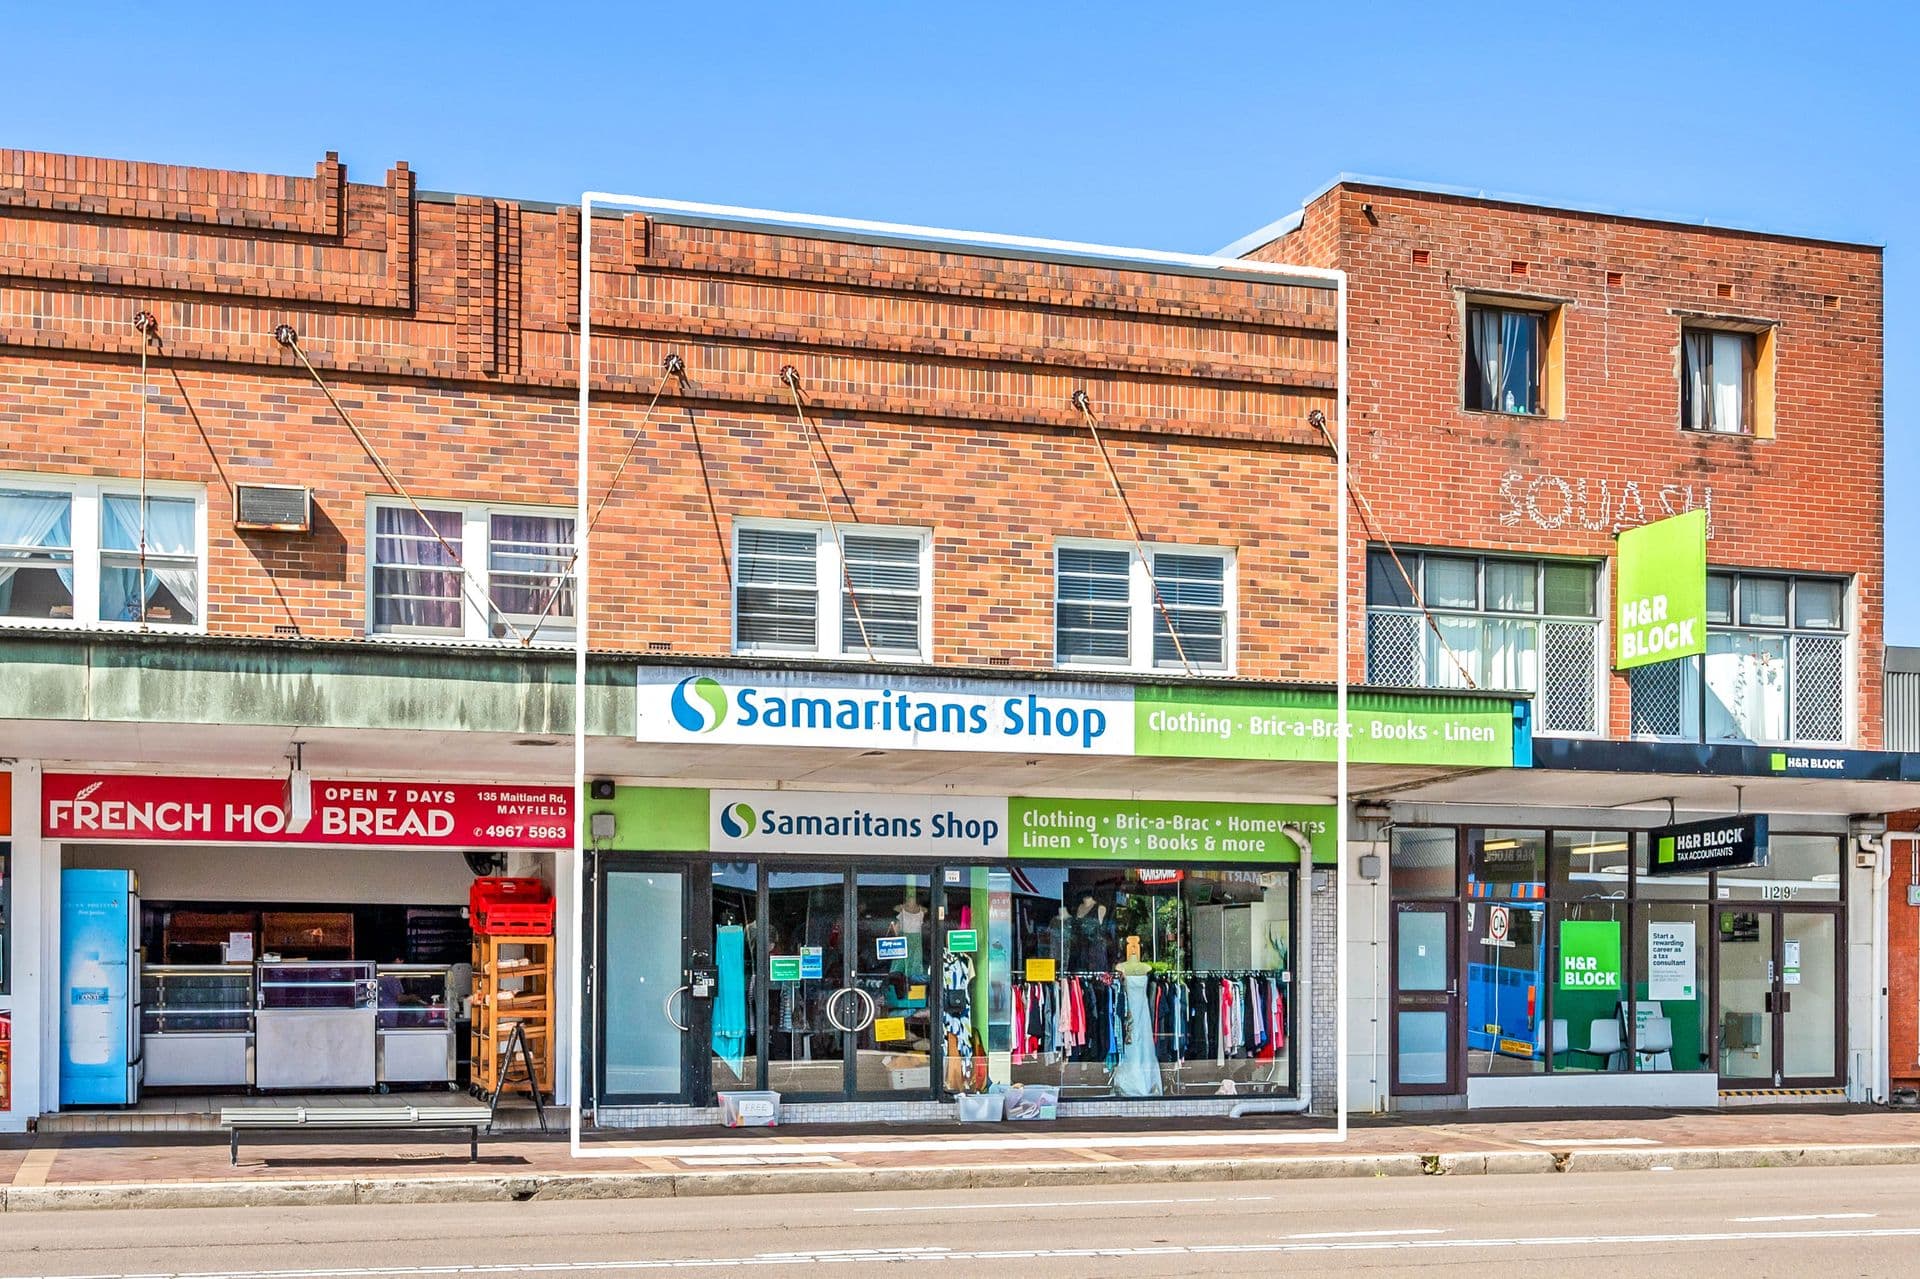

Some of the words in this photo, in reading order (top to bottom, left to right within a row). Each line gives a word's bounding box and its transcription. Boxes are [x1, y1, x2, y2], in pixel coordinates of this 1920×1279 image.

[1623, 595, 1667, 630] H&R
[1623, 619, 1694, 659] BLOCK
[737, 689, 988, 734] Samaritans
[1003, 694, 1106, 748] Shop
[1149, 710, 1231, 739] Clothing
[1371, 719, 1427, 740] Books
[1445, 721, 1495, 742] Linen
[1788, 757, 1809, 768] H&R
[1810, 758, 1845, 770] BLOCK
[325, 788, 378, 801] OPEN
[388, 790, 397, 802] 7
[406, 790, 456, 803] DAYS
[477, 792, 497, 801] 135
[500, 792, 546, 803] Maitland
[549, 793, 567, 804] Rd,
[49, 800, 211, 832] FRENCH
[225, 804, 287, 834] HO
[497, 805, 567, 816] MAYFIELD
[322, 806, 455, 837] BREAD
[486, 825, 523, 838] 4967
[528, 826, 567, 839] 5963
[762, 810, 922, 838] Samaritans
[932, 811, 999, 846] Shop
[1023, 811, 1096, 832] Clothing
[1116, 813, 1209, 831] Bric-a-Brac
[1023, 832, 1071, 848] Linen
[1090, 833, 1128, 853] Toys
[1148, 834, 1198, 851] Books
[1205, 835, 1222, 851] &
[1222, 838, 1265, 852] more
[1677, 834, 1701, 850] H&R
[1703, 828, 1743, 847] BLOCK
[1677, 852, 1688, 861] TAX
[1688, 847, 1733, 860] ACCOUNTANTS
[1564, 957, 1597, 970] H&R
[1564, 972, 1616, 985] BLOCK
